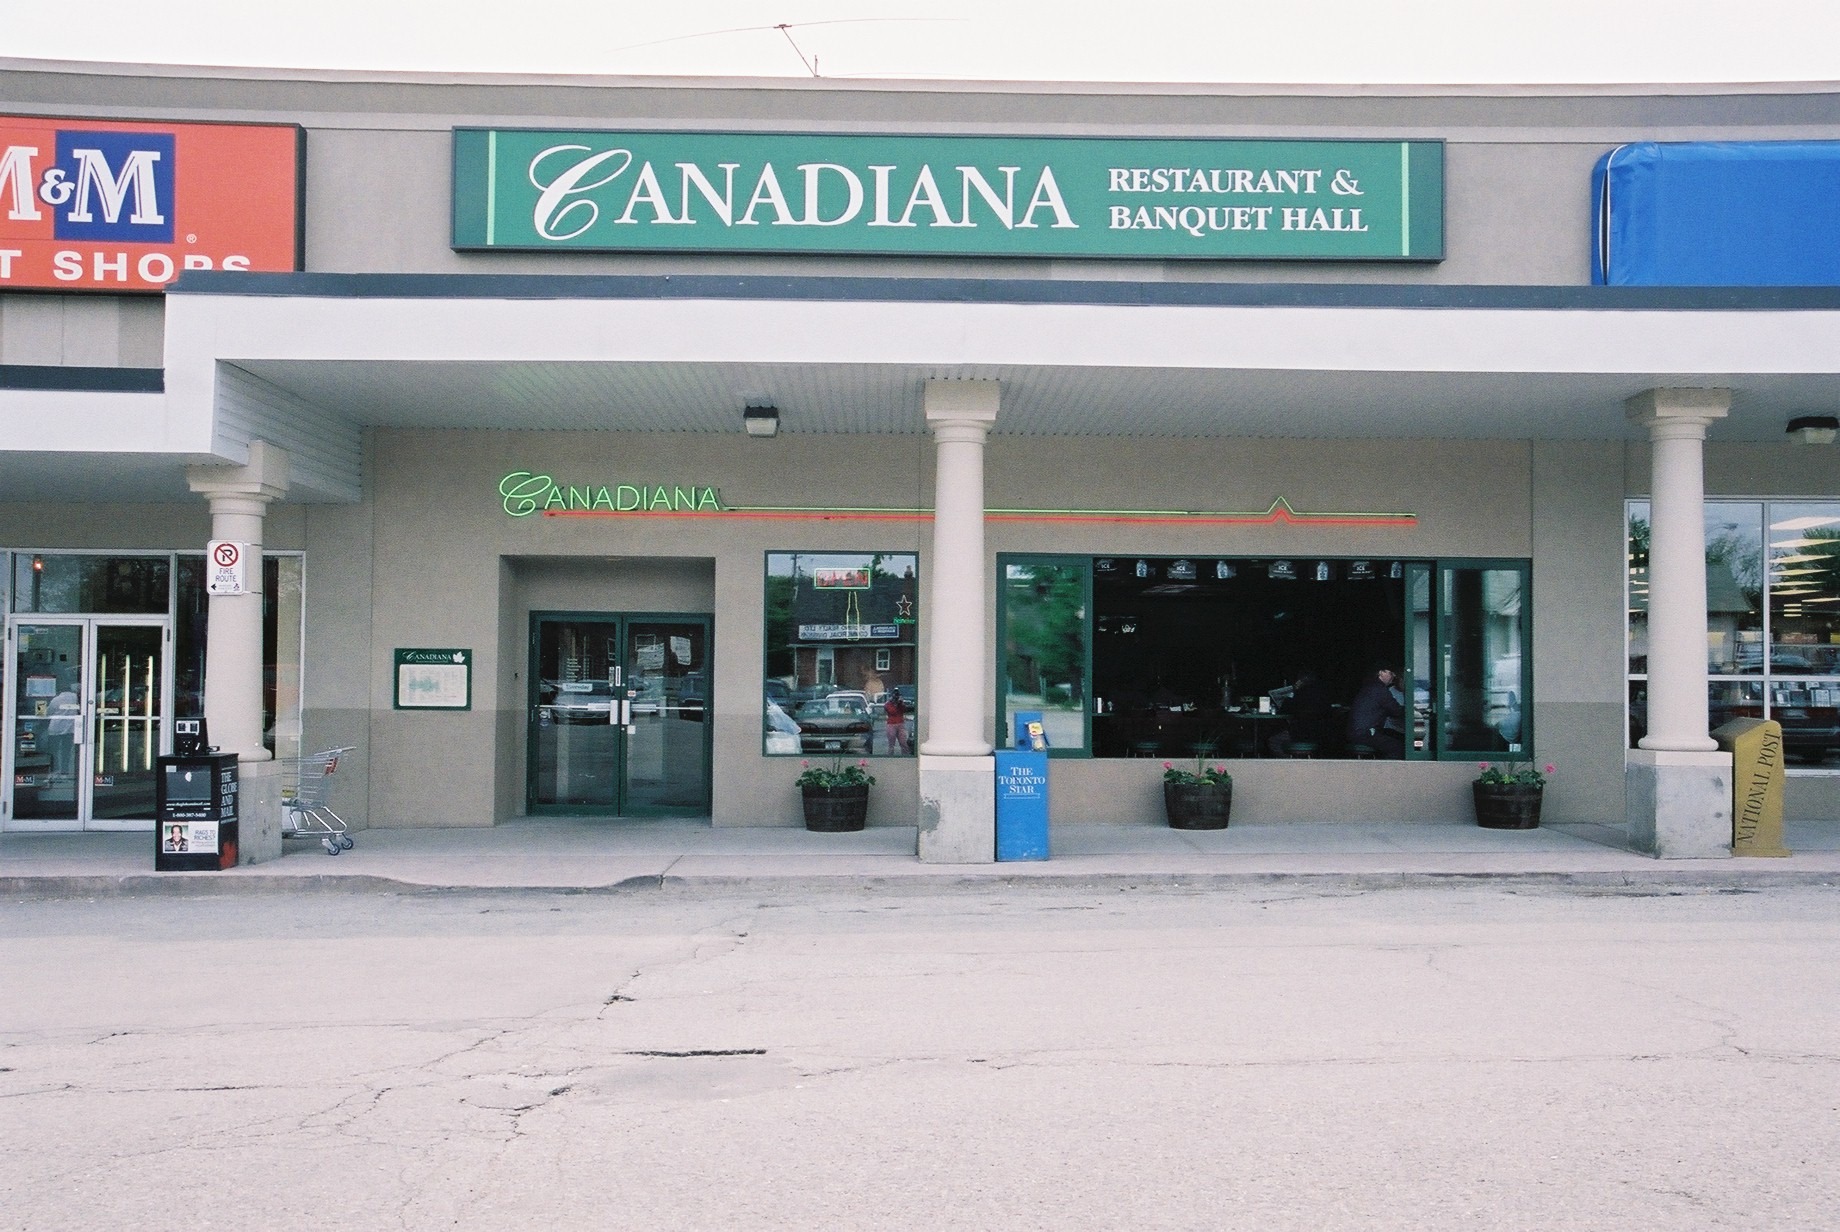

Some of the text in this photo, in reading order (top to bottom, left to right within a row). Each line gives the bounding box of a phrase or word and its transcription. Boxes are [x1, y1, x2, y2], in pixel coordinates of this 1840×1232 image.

[1108, 168, 1364, 196] RESTAURANT &
[529, 144, 1080, 241] CANADIANA
[1108, 206, 1369, 237] BANQUET HALL
[499, 472, 720, 517] CANADIANA
[219, 567, 234, 575] FIRE
[215, 574, 237, 583] ROUTE
[402, 651, 452, 661] CANADIANA
[220, 771, 232, 783] THE
[1010, 767, 1034, 776] THE
[998, 775, 1046, 785] TORONTO
[220, 782, 238, 795] GLOBE
[1009, 784, 1035, 794] STAR
[1737, 729, 1782, 844] NATIONAL POST
[220, 795, 234, 806] AND
[220, 806, 234, 818] MAIL
